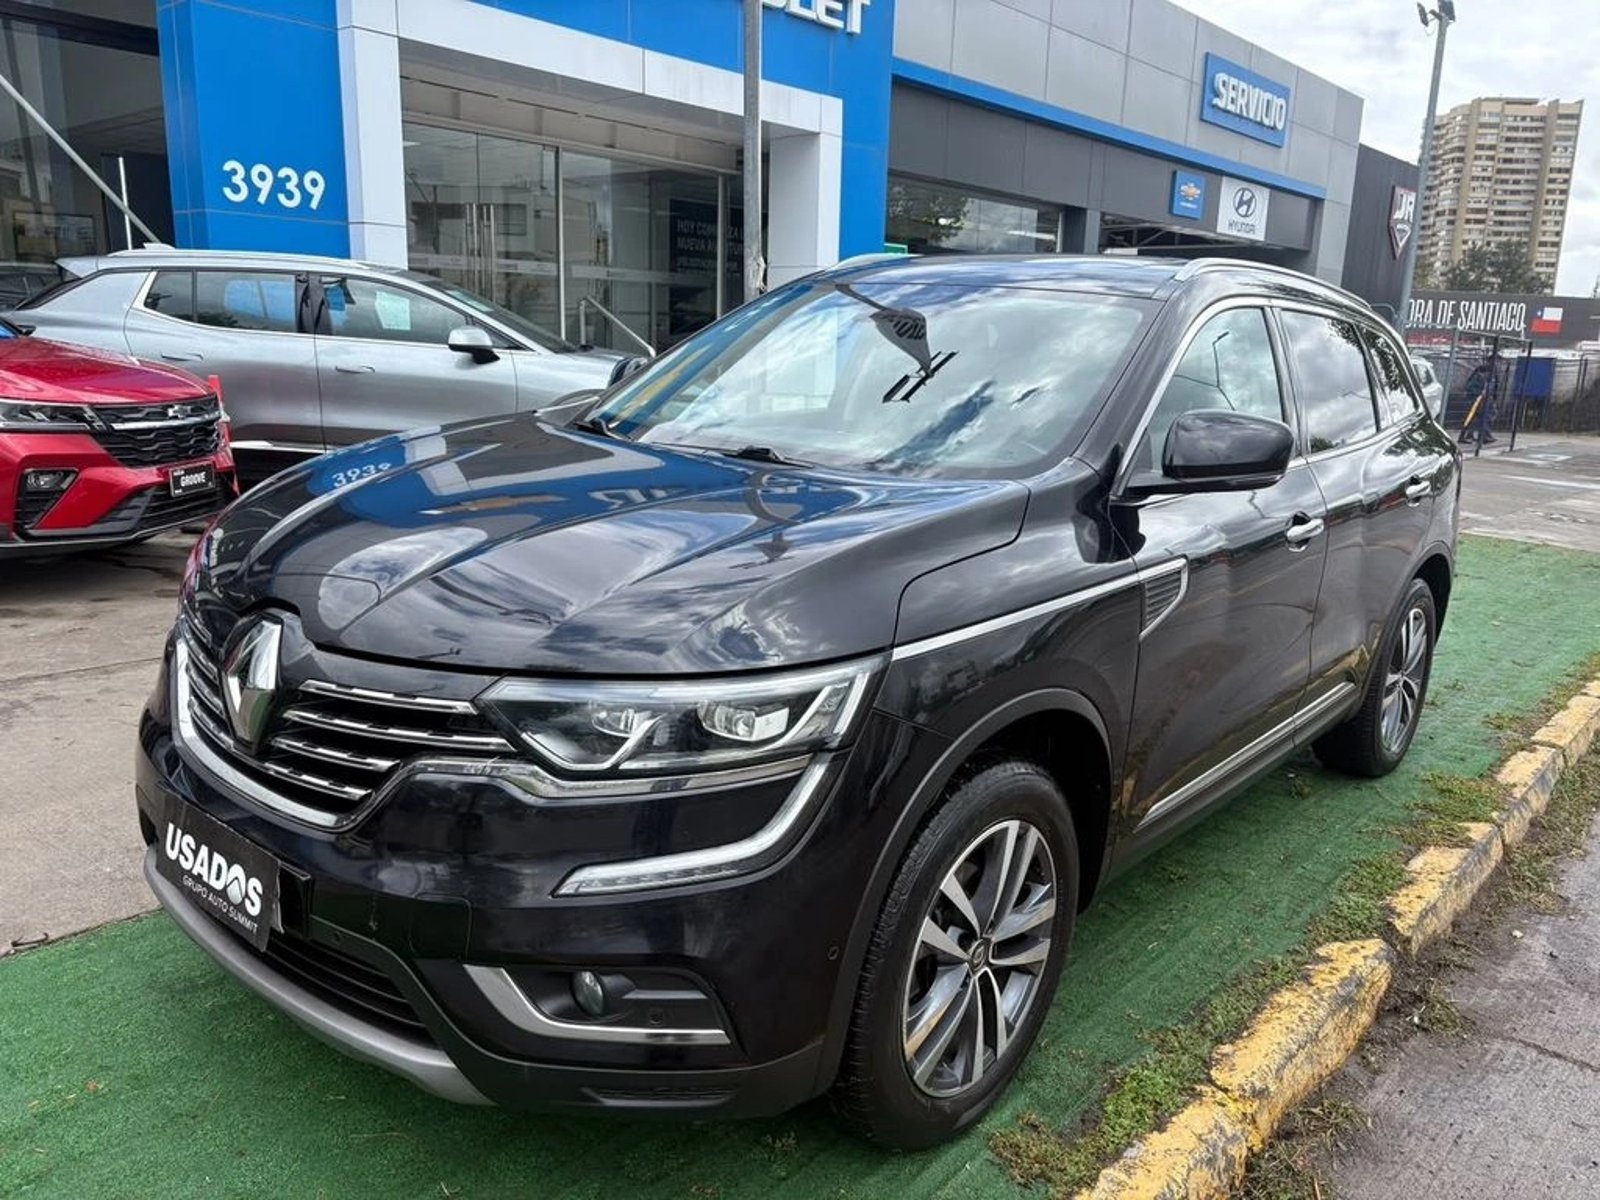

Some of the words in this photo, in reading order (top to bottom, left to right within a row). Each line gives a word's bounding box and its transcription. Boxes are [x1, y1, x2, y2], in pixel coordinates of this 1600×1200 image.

[761, 0, 871, 34] LET
[1212, 72, 1287, 131] SERVICIO
[222, 160, 326, 210] 3939
[1436, 300, 1457, 330] DE
[1457, 301, 1527, 332] SANTIAGO
[180, 471, 206, 487] GROOVE
[165, 822, 263, 917] USADOS
[182, 874, 208, 898] GRUPO
[208, 892, 229, 913] AUTO
[229, 906, 258, 934] SUMMIT
